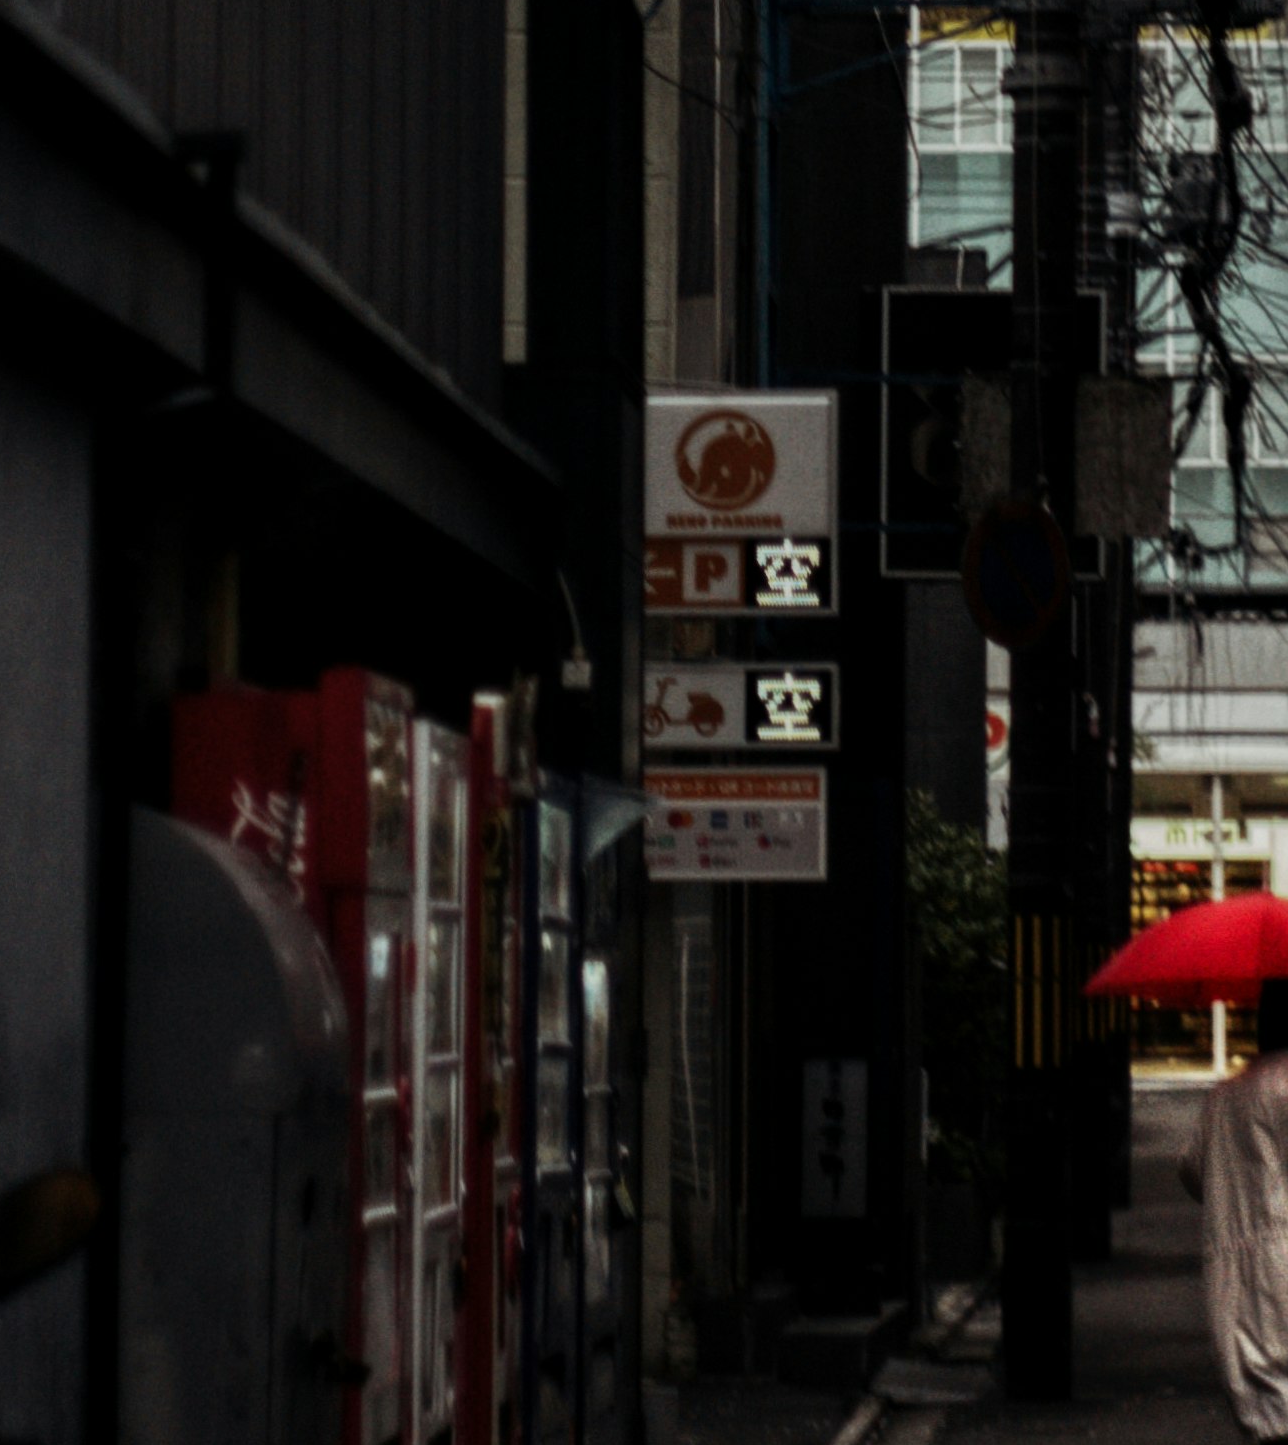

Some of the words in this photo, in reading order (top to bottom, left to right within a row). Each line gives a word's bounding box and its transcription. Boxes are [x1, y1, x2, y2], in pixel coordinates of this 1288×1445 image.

[694, 551, 728, 593] P
[755, 537, 821, 607] 空
[755, 671, 823, 742] 空
